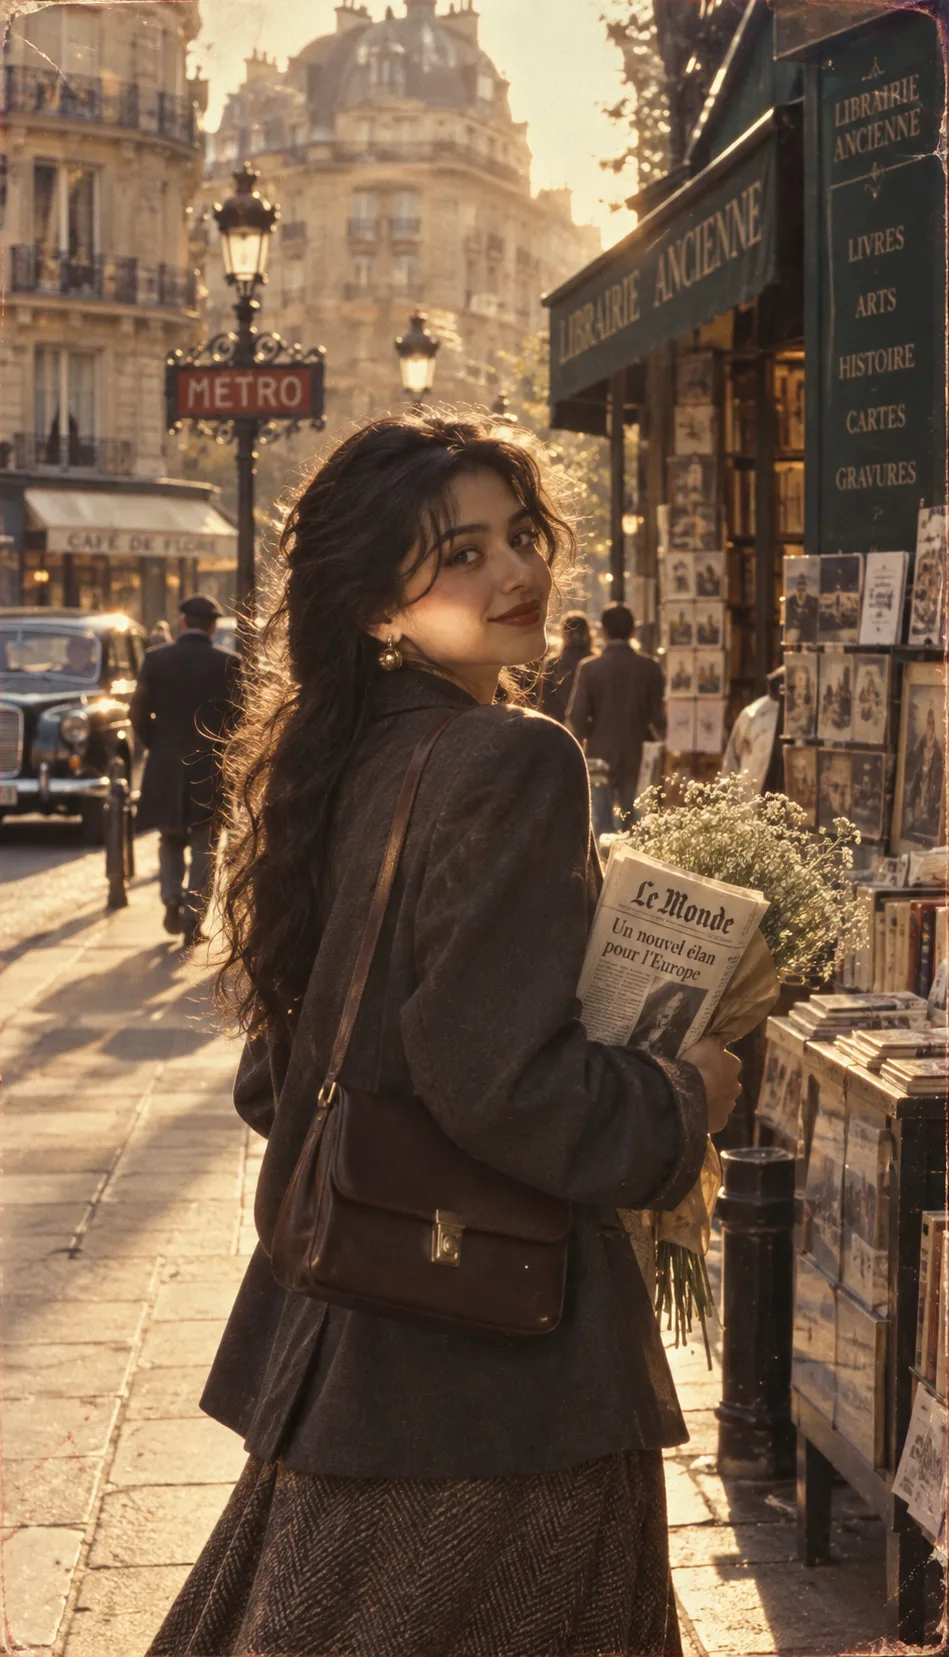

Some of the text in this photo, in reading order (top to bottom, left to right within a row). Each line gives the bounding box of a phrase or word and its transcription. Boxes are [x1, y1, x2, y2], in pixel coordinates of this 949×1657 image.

[835, 74, 919, 127] LIBRAIRIE
[833, 108, 920, 162] ANCIENNE
[848, 225, 904, 263] LIVRES
[559, 180, 763, 364] LIBRAIRIE ANCIENNE
[856, 288, 896, 319] ARTS
[839, 344, 915, 379] HISTOIRE
[846, 404, 906, 434] CARTES
[836, 461, 917, 491] GRAVURES
[630, 881, 659, 909] Le
[657, 888, 735, 934] Monde
[601, 941, 700, 983] pour l'Europe
[612, 917, 633, 939] Un
[636, 929, 686, 956] nouvel
[686, 944, 716, 966] élan
